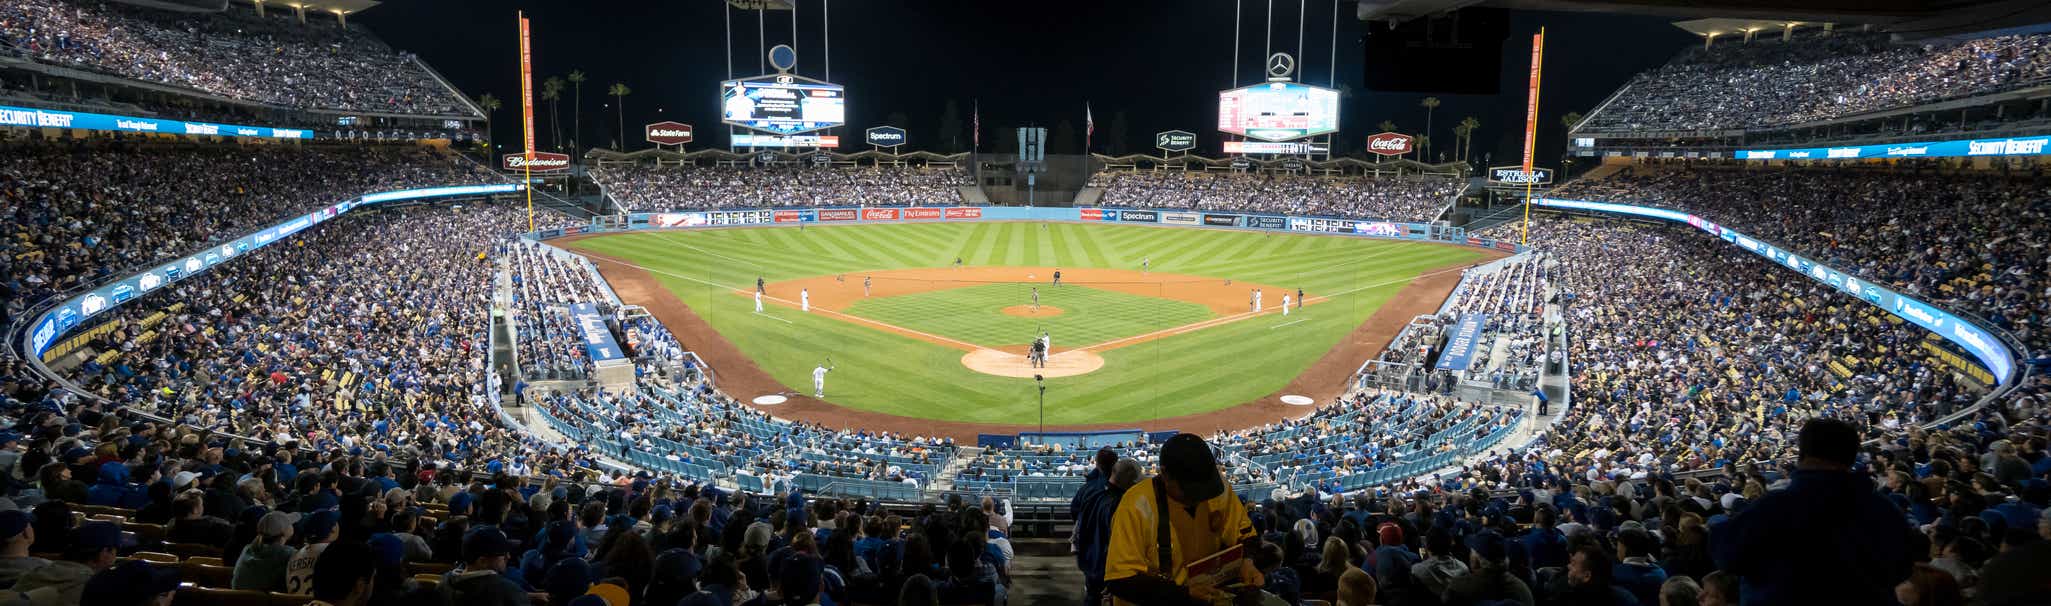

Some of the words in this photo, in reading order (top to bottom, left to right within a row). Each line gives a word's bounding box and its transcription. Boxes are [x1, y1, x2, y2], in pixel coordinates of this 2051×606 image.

[37, 110, 71, 127] BENEFIT
[870, 132, 901, 141] Spectrum
[1371, 138, 1409, 150] Coca-Cola
[1968, 140, 2006, 155] SECURITY
[2005, 139, 2043, 155] BENEFIT
[507, 157, 567, 167] Budweiser
[1123, 212, 1154, 220] Spectrum
